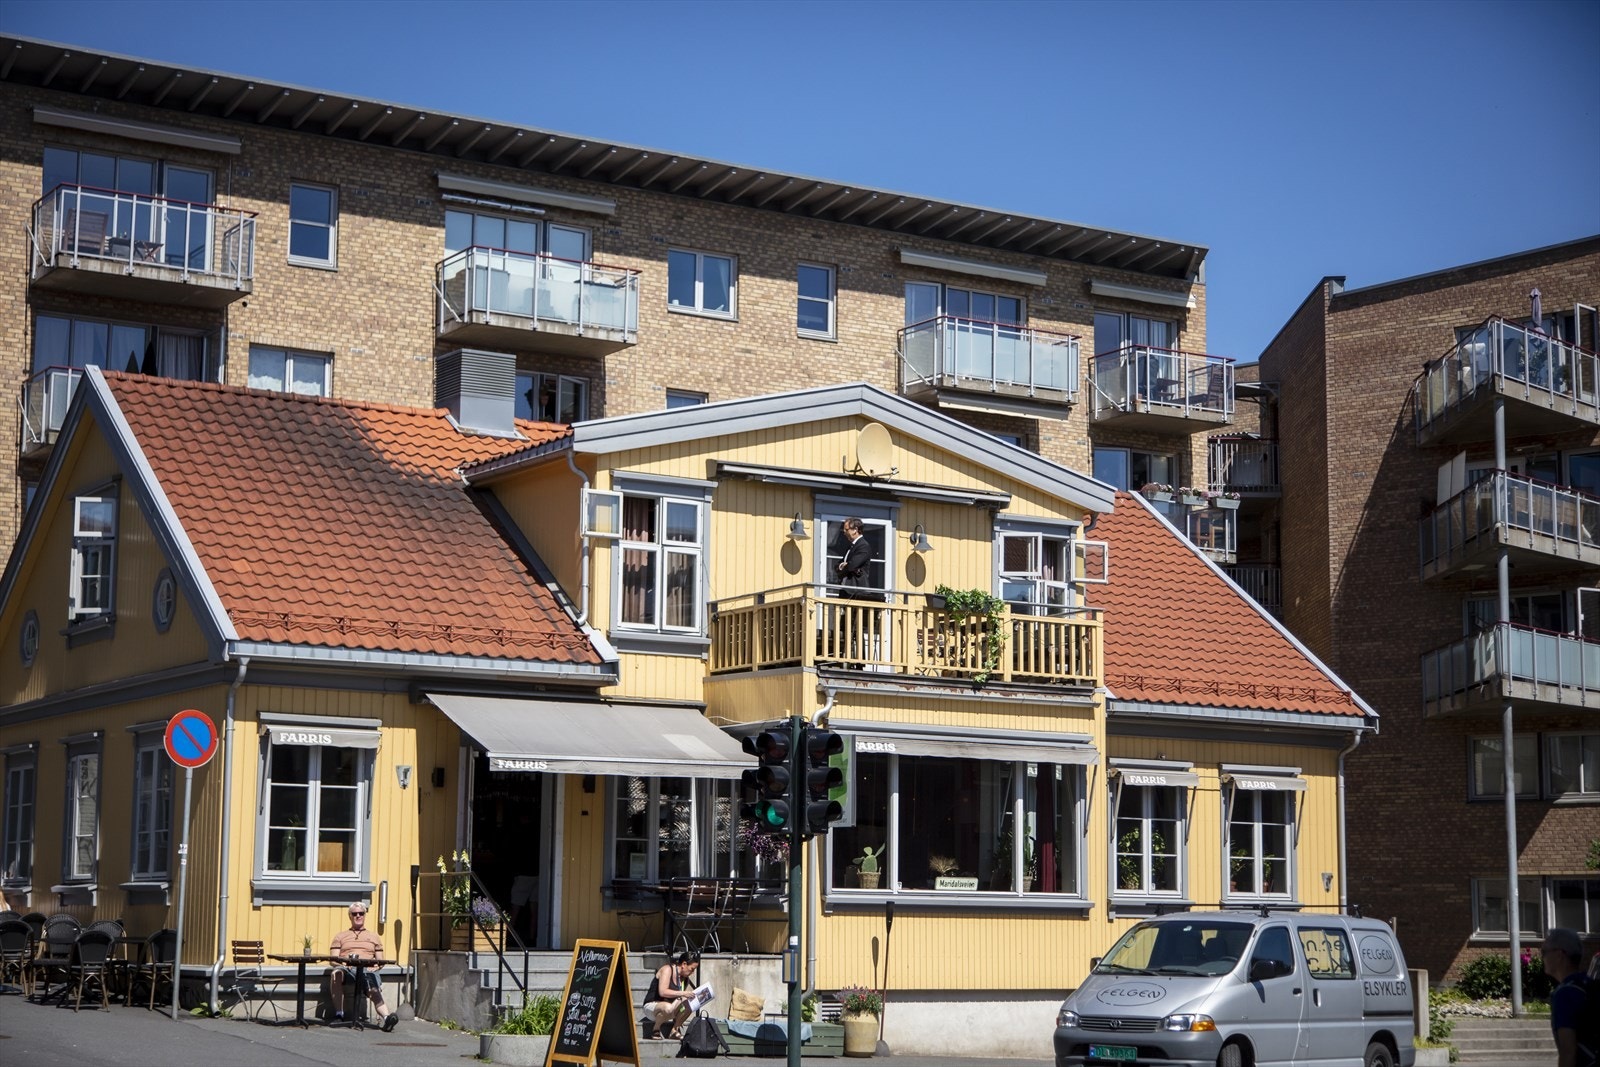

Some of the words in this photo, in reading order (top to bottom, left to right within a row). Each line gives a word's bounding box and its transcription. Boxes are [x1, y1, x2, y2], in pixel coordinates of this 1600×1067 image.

[279, 732, 332, 744] FARRIS
[498, 759, 548, 770] FARRIS
[1130, 775, 1167, 785] FARRIS
[1241, 780, 1277, 790] FARRIS
[1362, 948, 1393, 960] FELGEN
[1101, 988, 1160, 999] FELGEN
[1364, 981, 1408, 996] ELSYKLER
